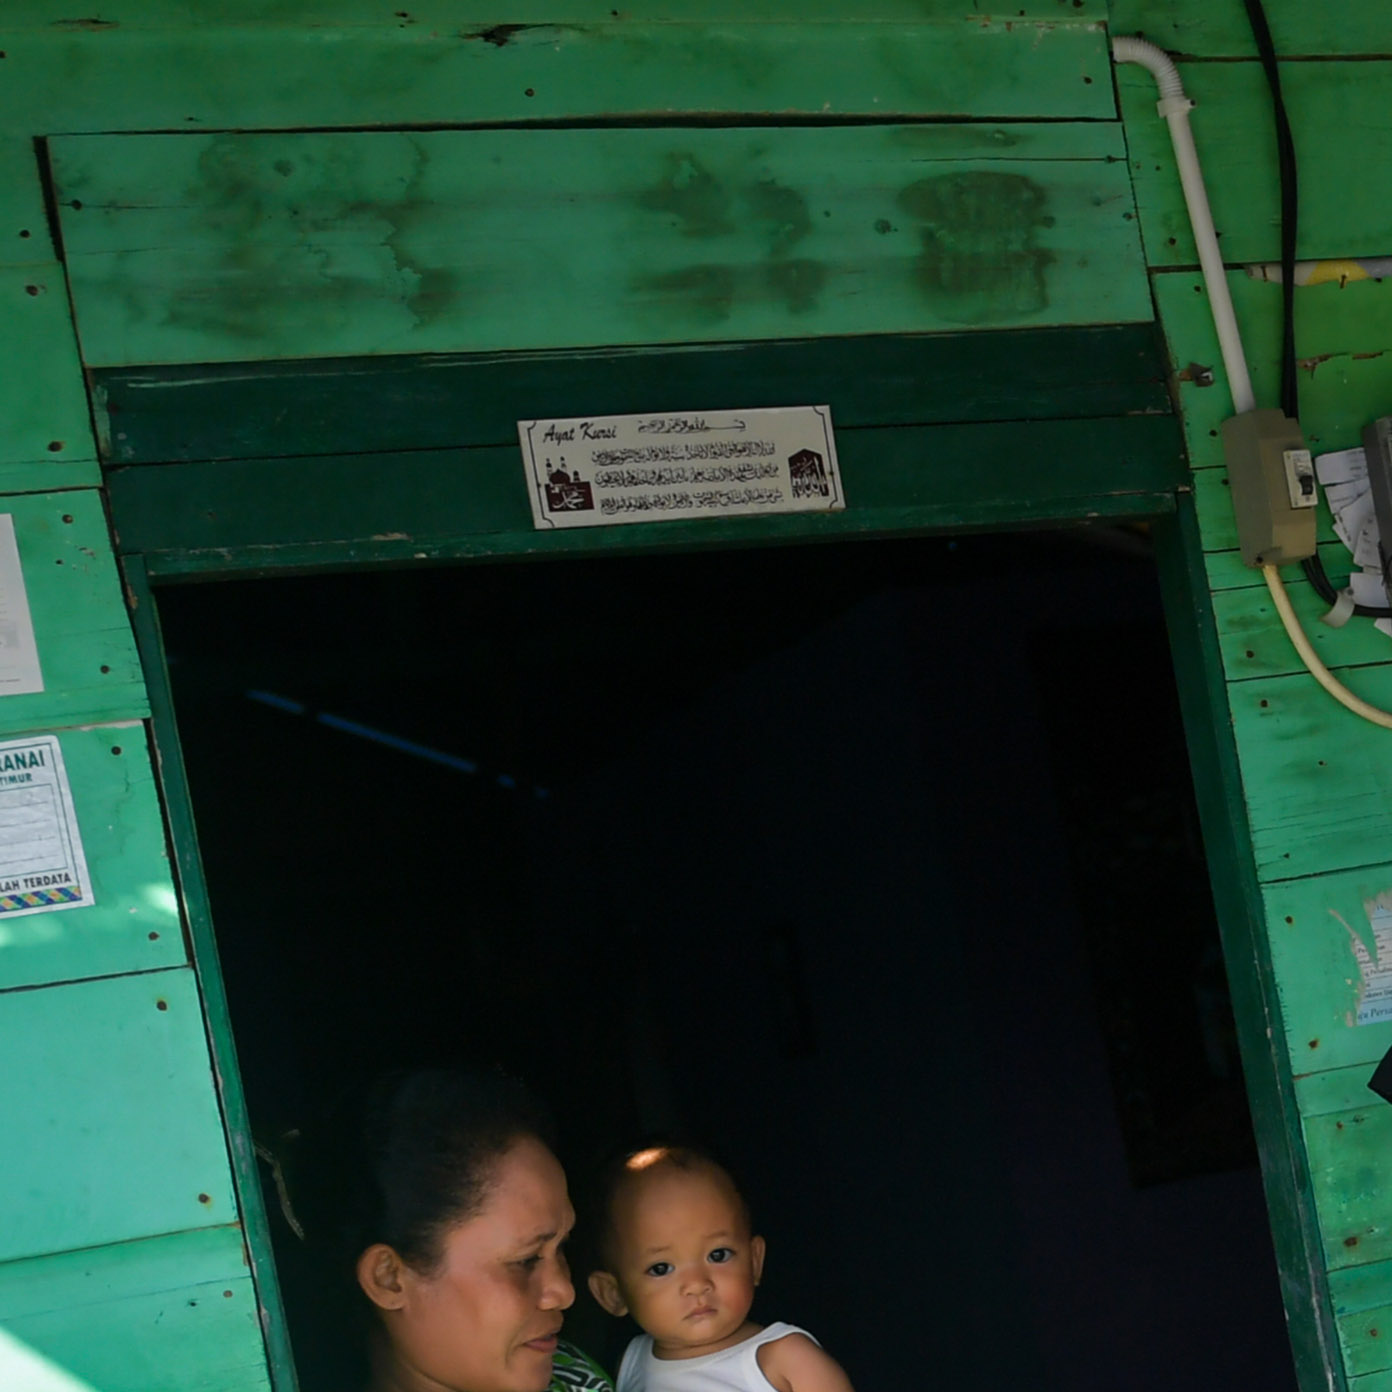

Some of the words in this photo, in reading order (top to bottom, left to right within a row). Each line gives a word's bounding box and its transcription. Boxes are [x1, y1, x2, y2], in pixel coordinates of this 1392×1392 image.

[543, 423, 575, 444] Ayat
[580, 421, 617, 441] Kursi
[0, 772, 32, 786] TIMUR
[23, 872, 72, 888] TERDATA
